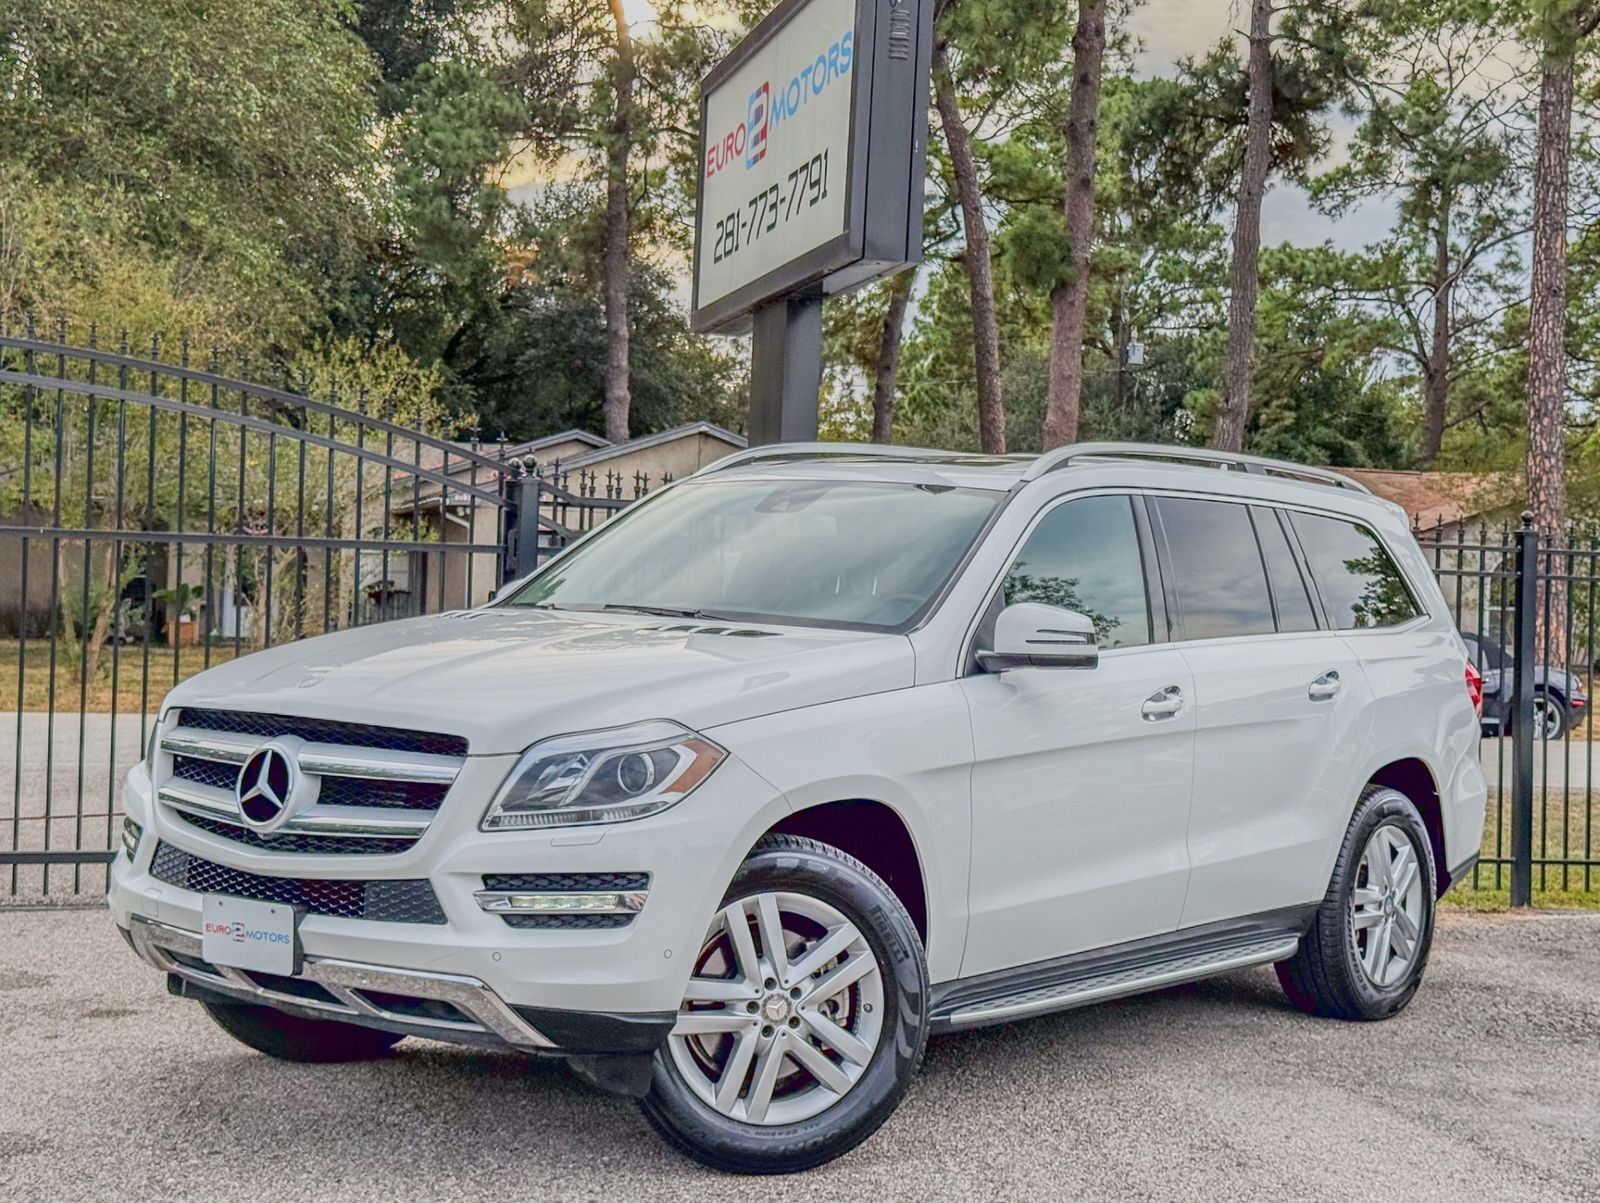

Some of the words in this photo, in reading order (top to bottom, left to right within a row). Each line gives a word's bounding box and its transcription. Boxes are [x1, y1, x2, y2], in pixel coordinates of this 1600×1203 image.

[706, 122, 746, 179] EURO
[769, 31, 854, 131] MOTORS
[713, 147, 829, 265] 281-773-7791
[205, 923, 232, 935] EURO
[245, 930, 290, 944] MOTORS
[868, 904, 909, 963] PIRELLI
